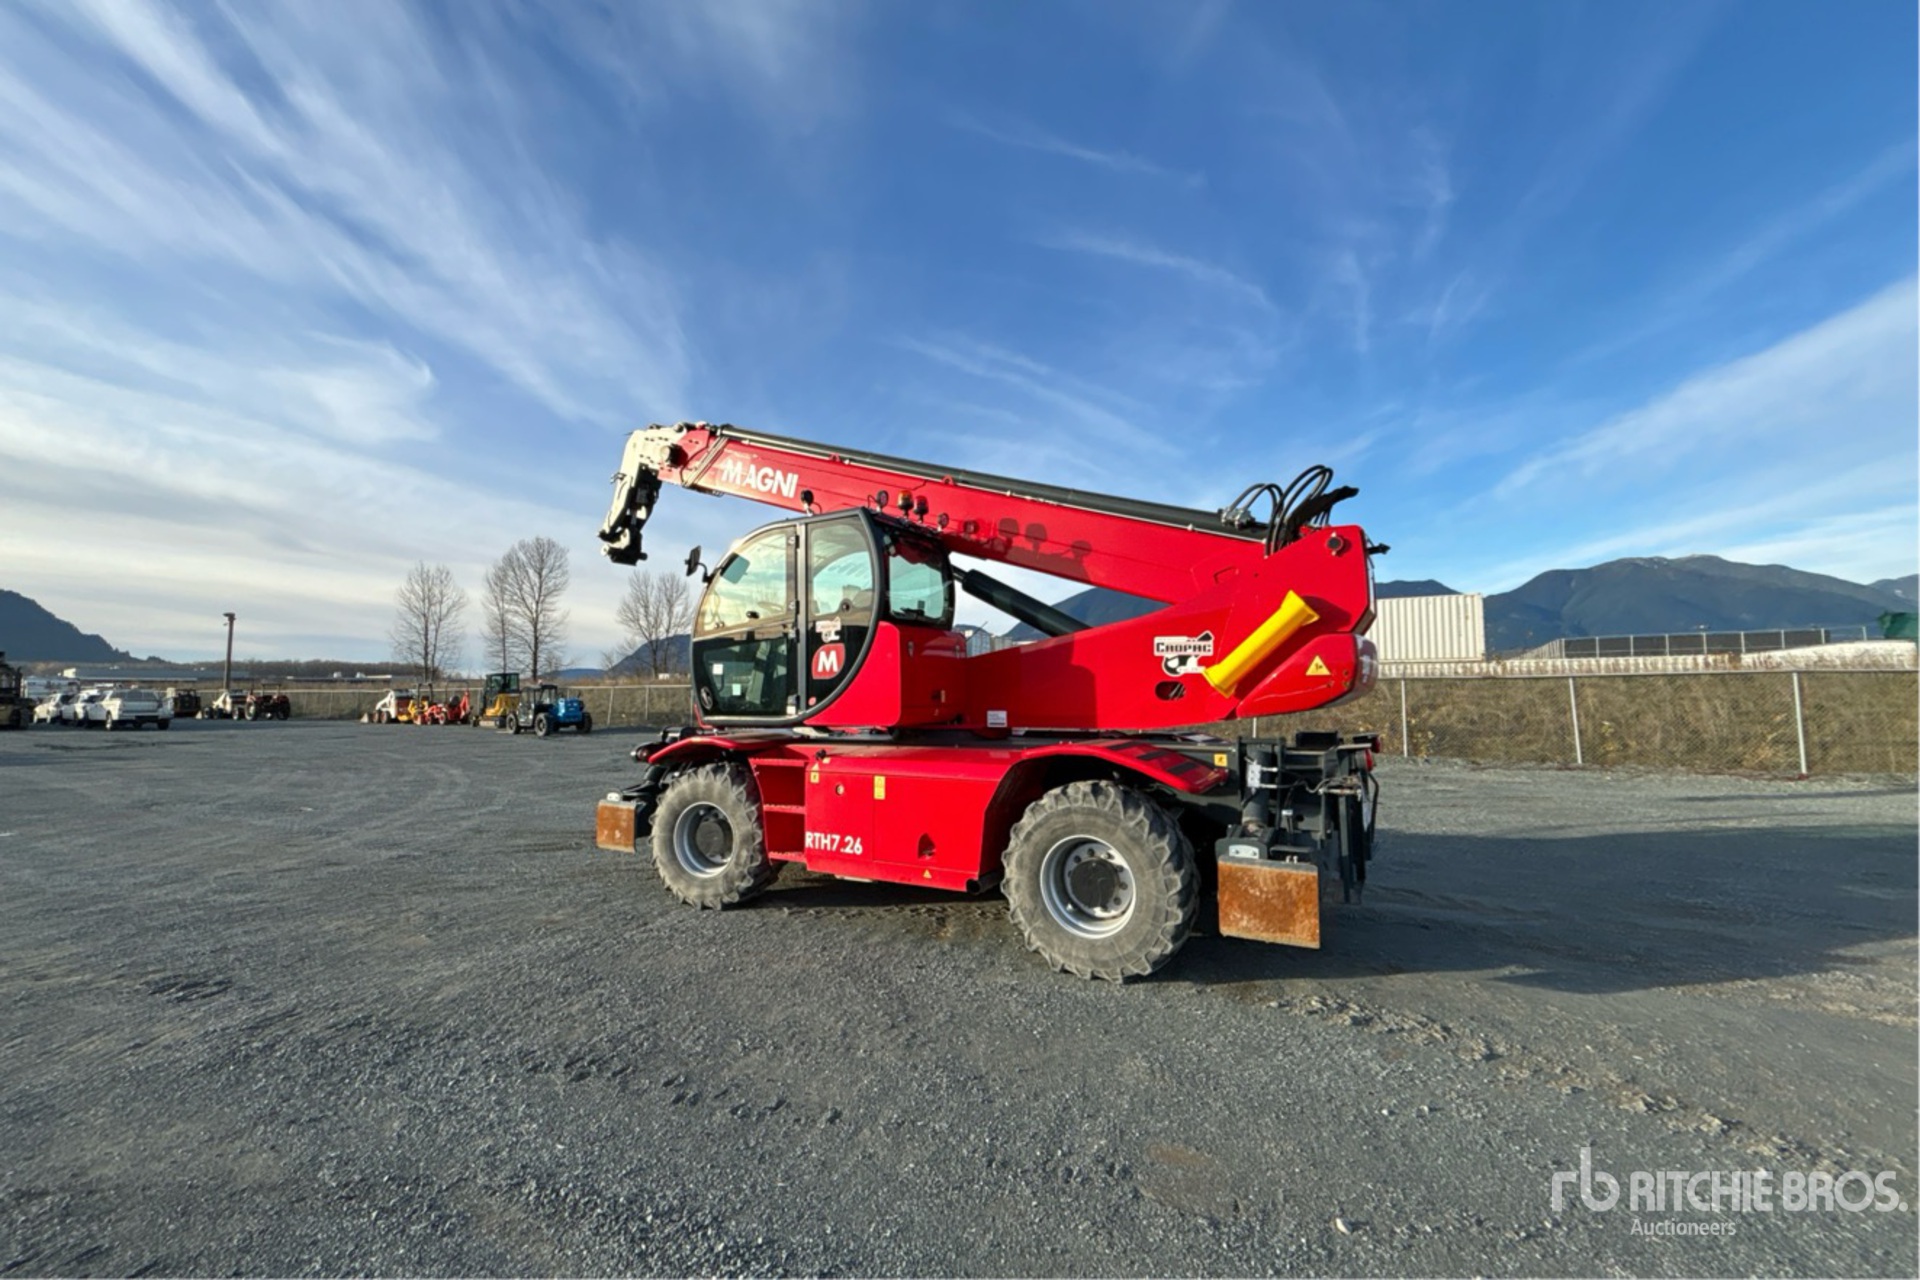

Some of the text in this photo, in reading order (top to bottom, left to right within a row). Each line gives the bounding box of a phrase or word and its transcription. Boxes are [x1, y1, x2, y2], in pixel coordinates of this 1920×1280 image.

[721, 458, 799, 499] MAGNI
[817, 650, 839, 673] M
[805, 831, 863, 856] RTH7.26
